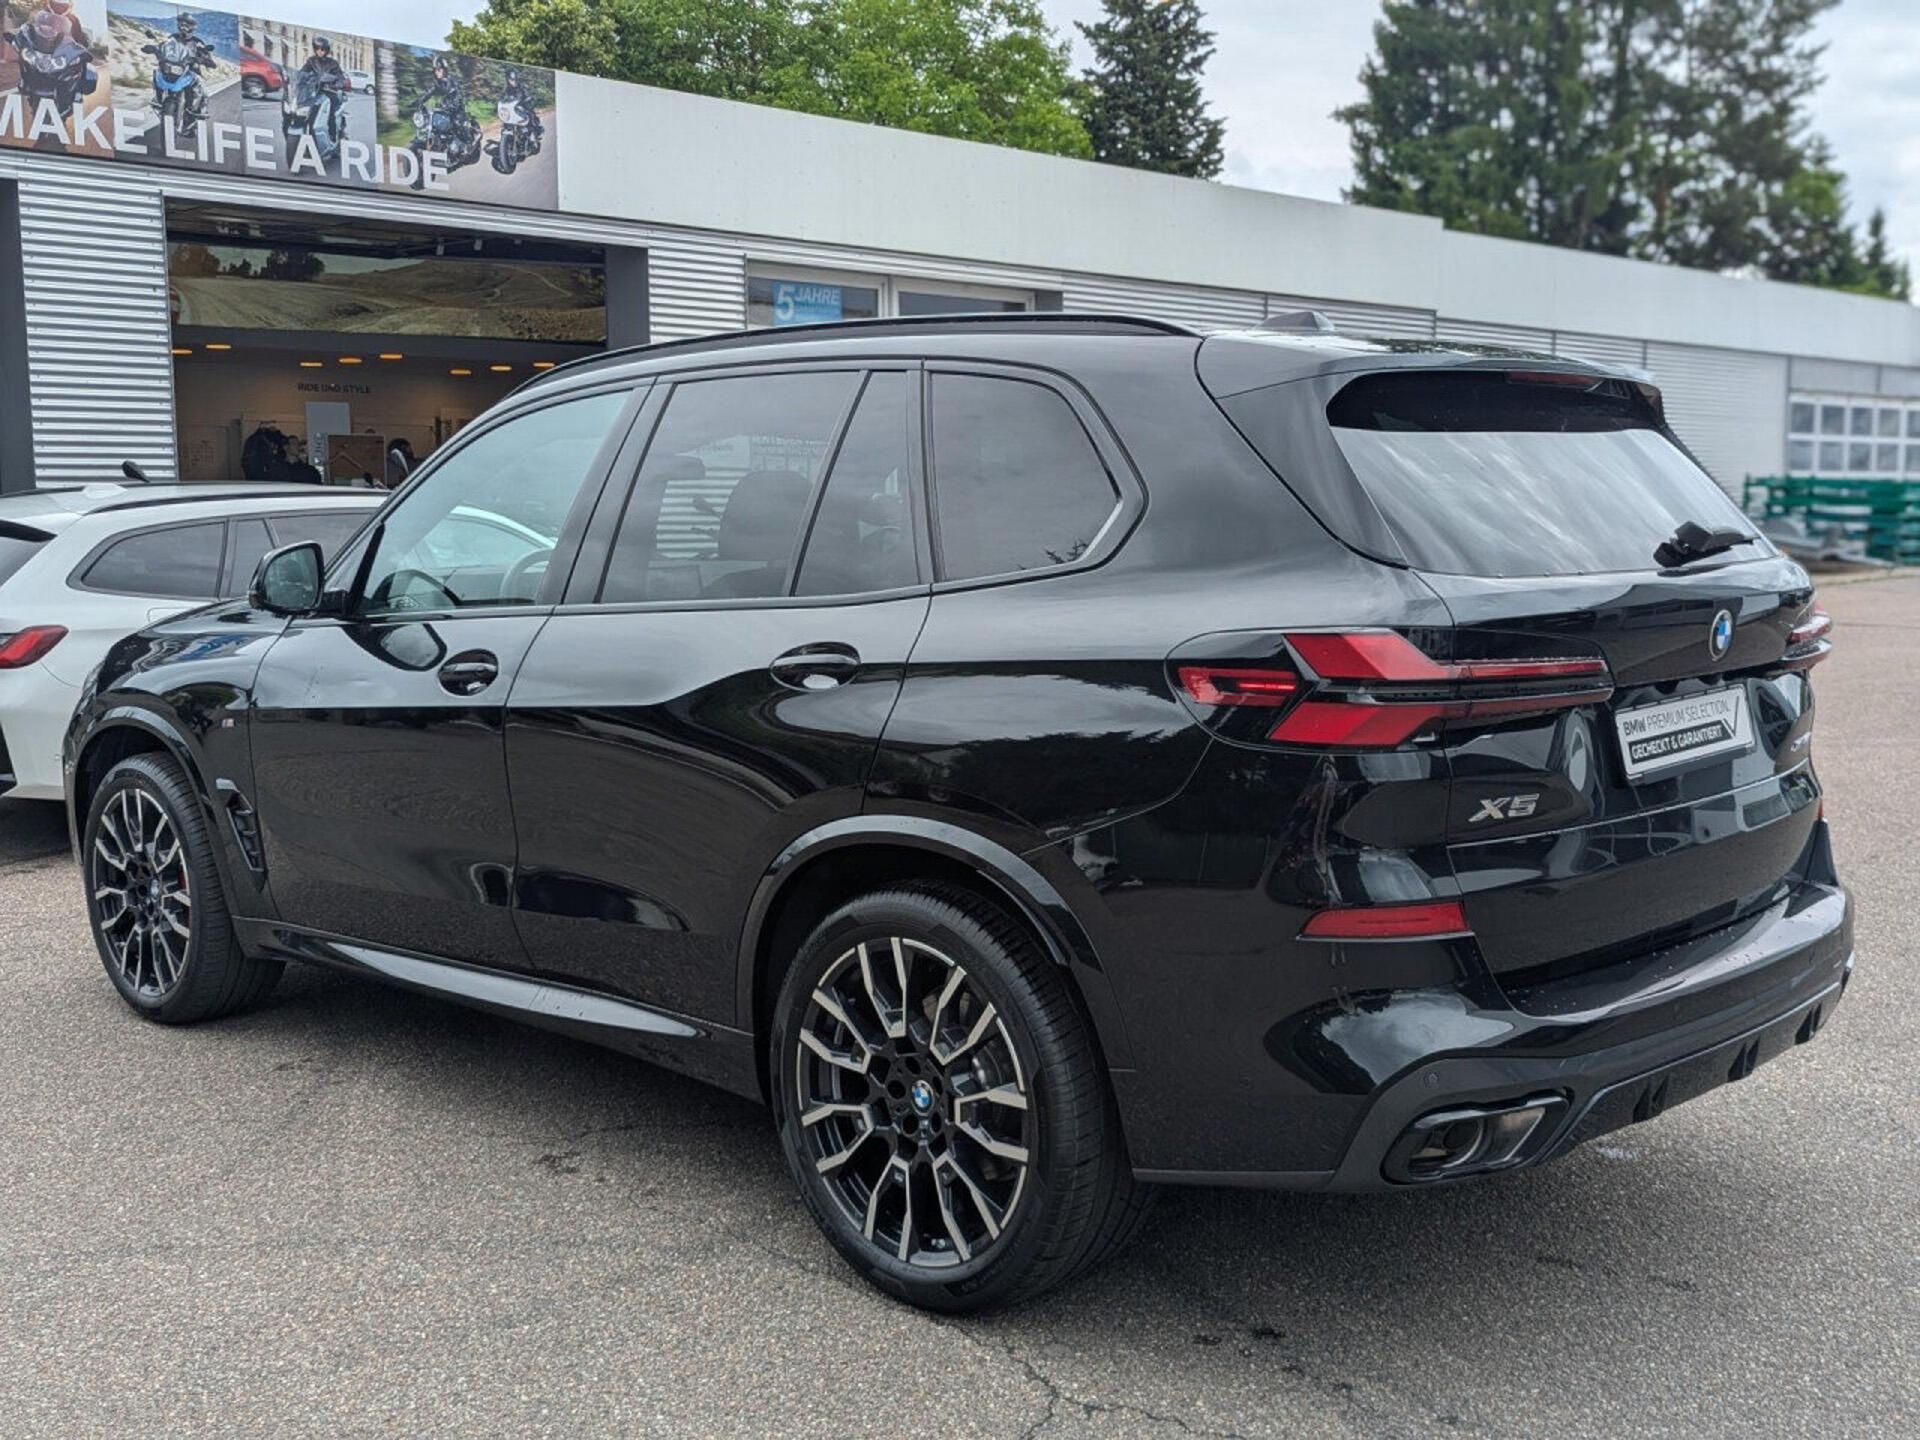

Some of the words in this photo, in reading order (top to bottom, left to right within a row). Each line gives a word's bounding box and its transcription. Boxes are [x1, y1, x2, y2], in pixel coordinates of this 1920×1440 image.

[164, 115, 277, 170] LIFE
[290, 134, 327, 177] A
[340, 139, 449, 191] RIDE
[775, 284, 795, 320] 5
[795, 286, 841, 305] JAHRE
[1622, 717, 1647, 736] BMW
[1647, 706, 1685, 730] PREMIUM
[1631, 737, 1670, 759] GECHECKT
[1671, 735, 1678, 749] &
[1678, 725, 1723, 747] GARANTIERT
[1468, 793, 1540, 822] X5
